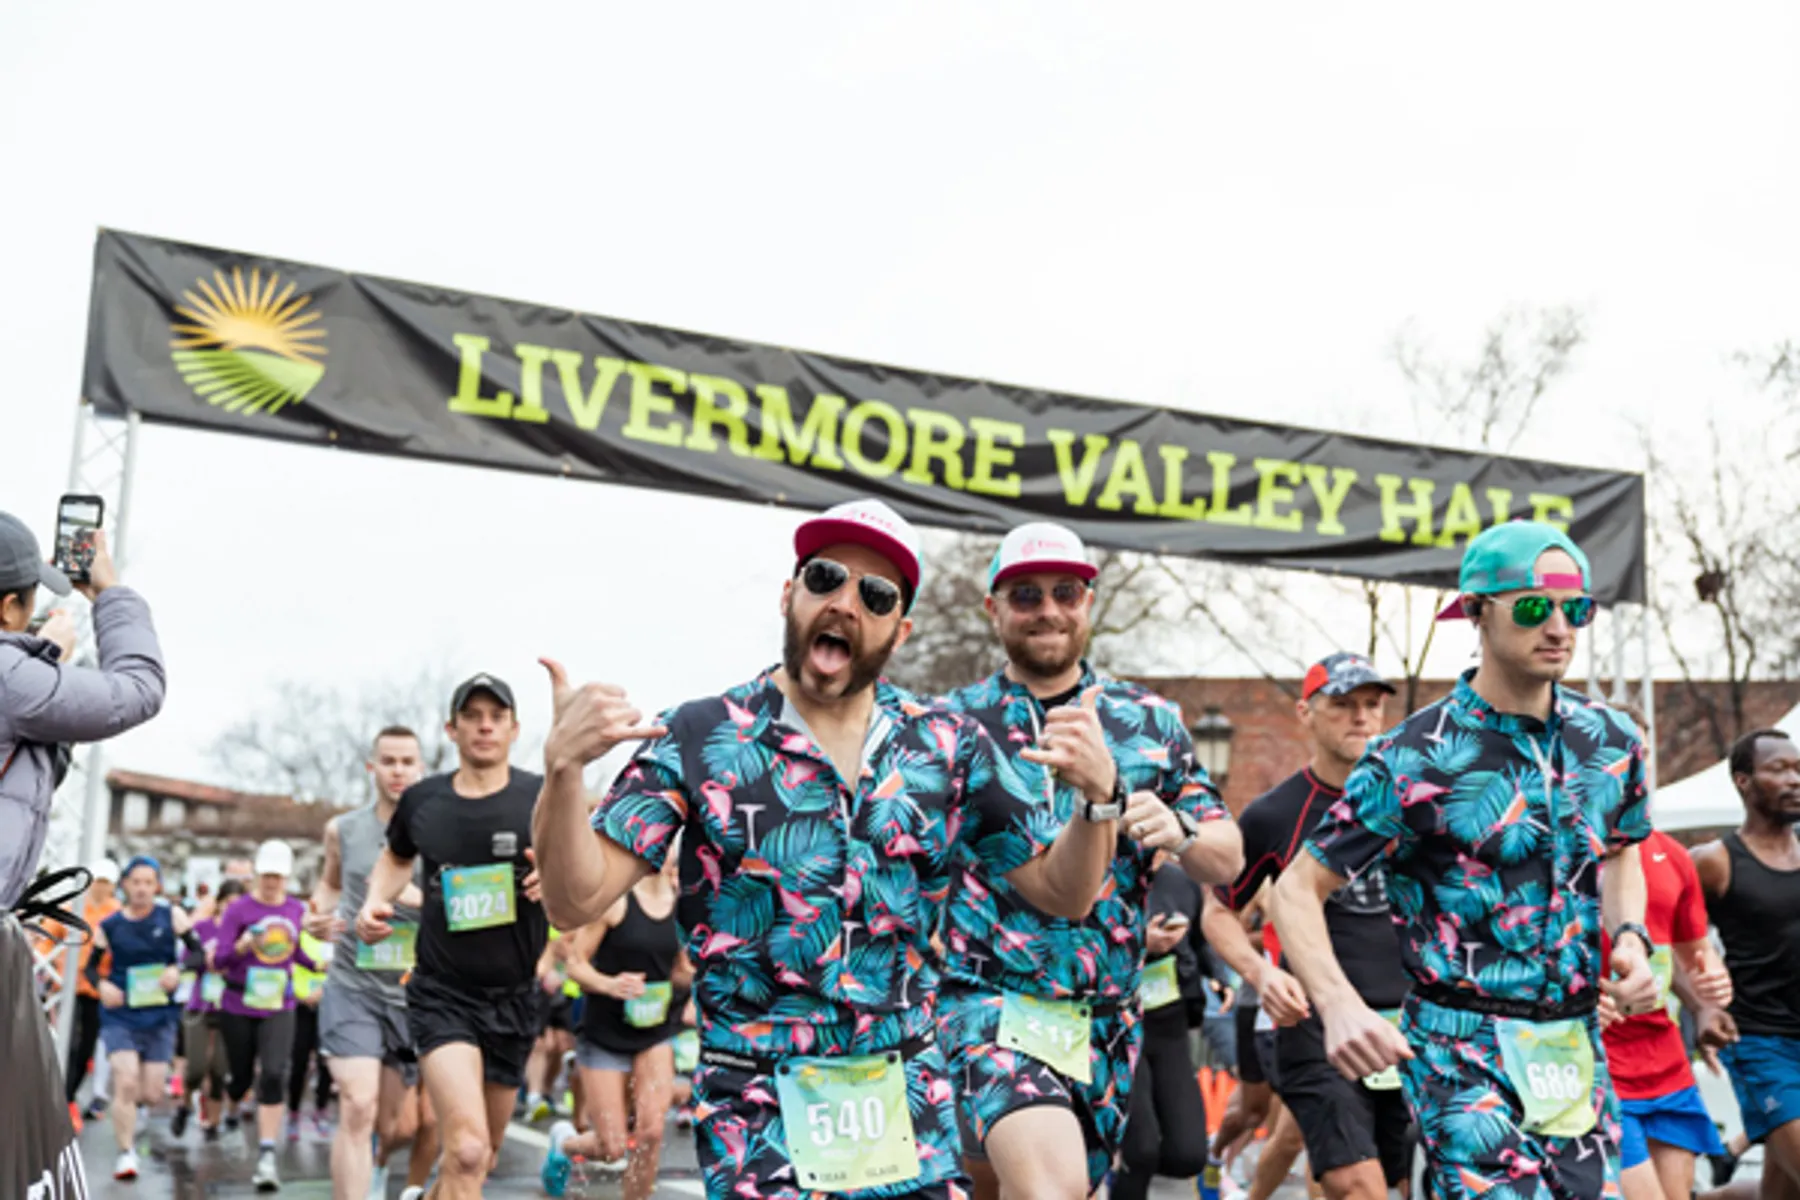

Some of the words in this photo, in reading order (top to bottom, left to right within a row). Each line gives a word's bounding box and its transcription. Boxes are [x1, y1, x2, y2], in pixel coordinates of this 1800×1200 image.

[447, 332, 1025, 498] LIVERMORE
[1046, 428, 1358, 536] VALLEY
[450, 890, 507, 922] 2024
[1526, 1061, 1584, 1102] 688
[807, 1096, 885, 1146] 540
